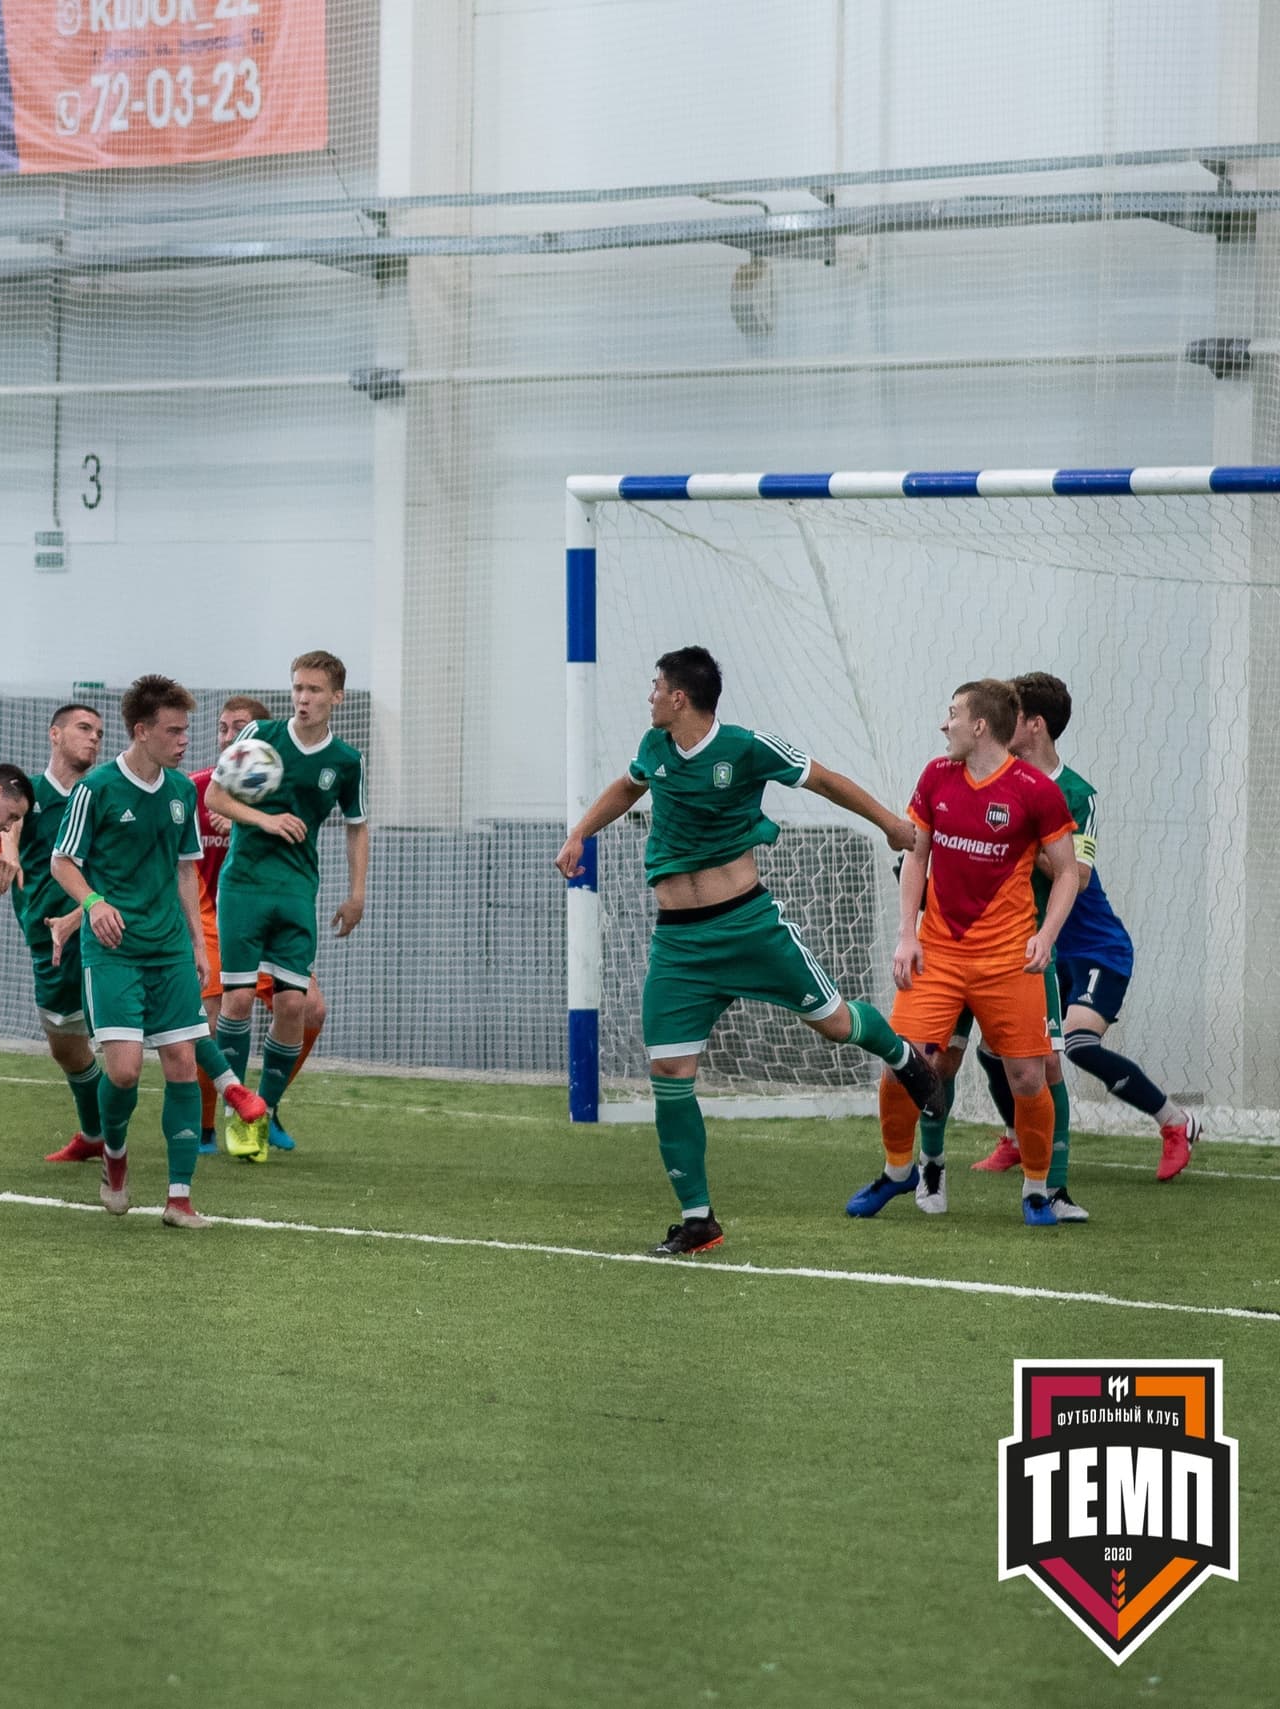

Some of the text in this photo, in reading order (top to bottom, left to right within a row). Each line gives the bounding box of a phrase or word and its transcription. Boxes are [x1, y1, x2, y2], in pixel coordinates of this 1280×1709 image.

[90, 58, 262, 134] 72-03-23
[82, 453, 101, 509] 3
[1087, 968, 1100, 994] 1
